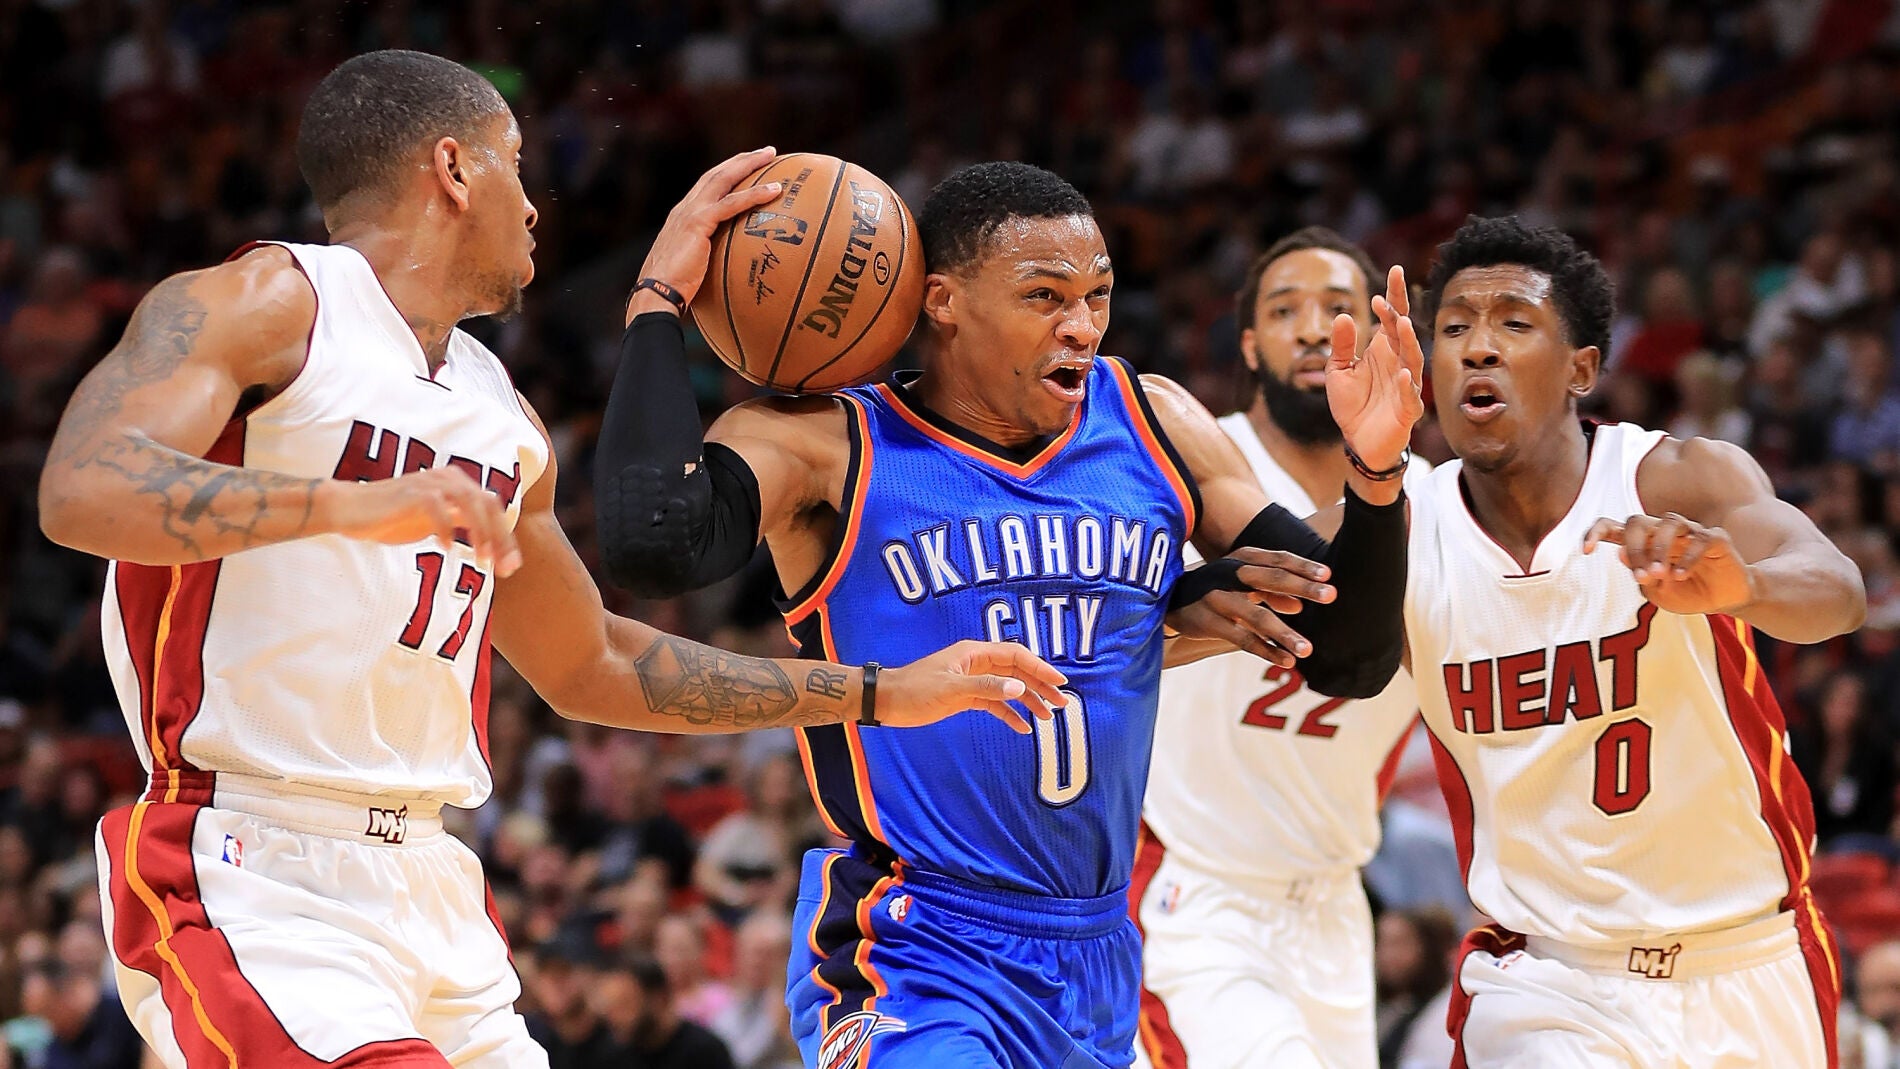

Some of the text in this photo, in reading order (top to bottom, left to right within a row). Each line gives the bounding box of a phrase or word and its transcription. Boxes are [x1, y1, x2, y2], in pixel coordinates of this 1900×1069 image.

[398, 551, 487, 662] 17
[880, 512, 1170, 604] OKLAHOMA
[983, 594, 1107, 662] CITY
[1442, 600, 1659, 735] HEAT
[1030, 683, 1094, 810] 0
[1241, 664, 1352, 738] 22
[1593, 717, 1652, 817] 0
